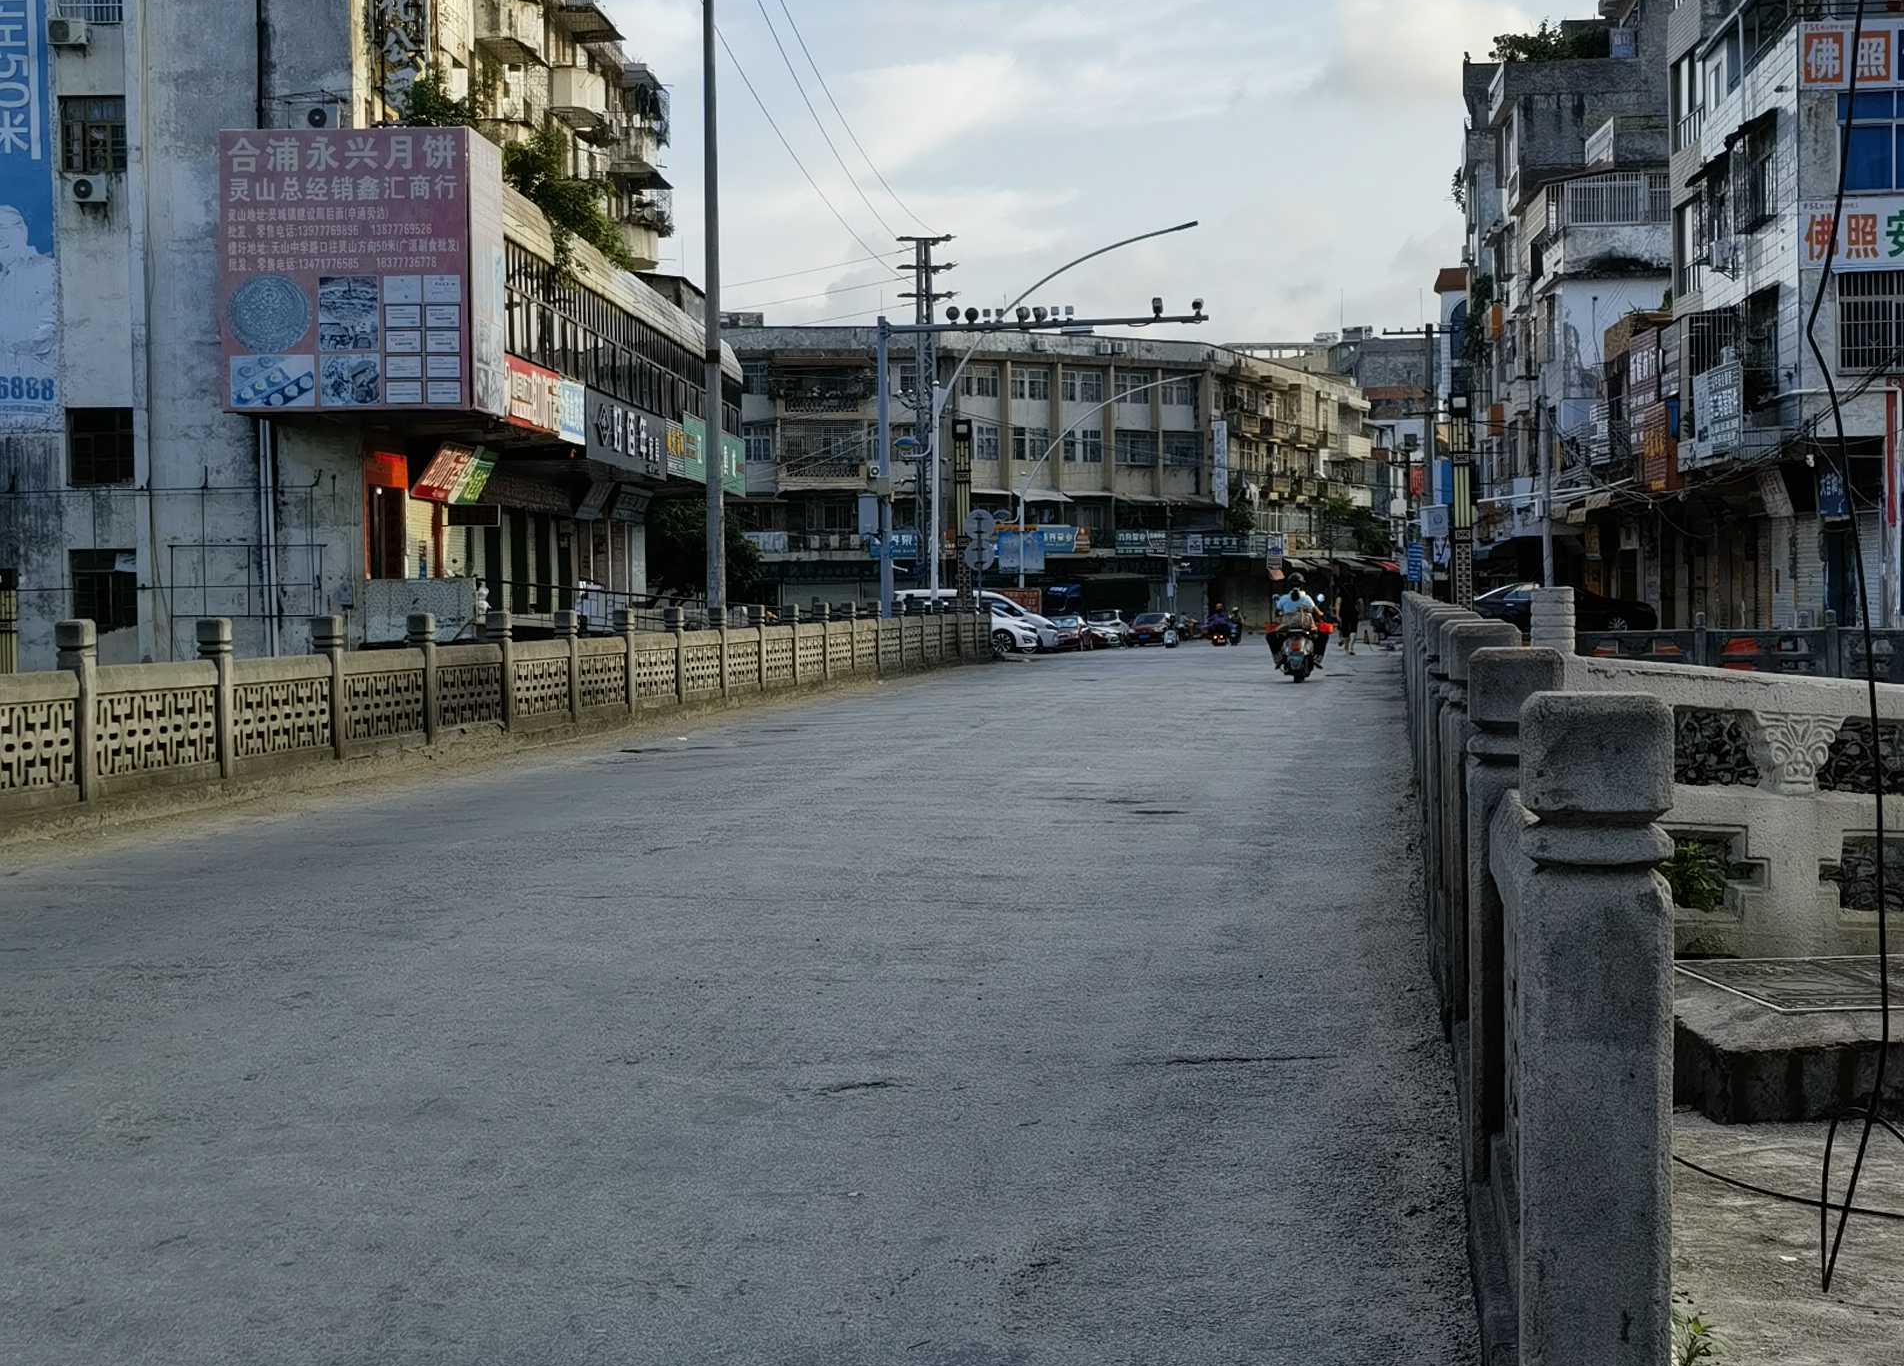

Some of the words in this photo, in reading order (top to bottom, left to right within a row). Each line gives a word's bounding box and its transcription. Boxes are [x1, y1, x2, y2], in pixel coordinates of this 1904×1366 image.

[227, 134, 457, 173] 合浦永兴月饼
[228, 174, 457, 203] 灵山总经销鑫汇商行
